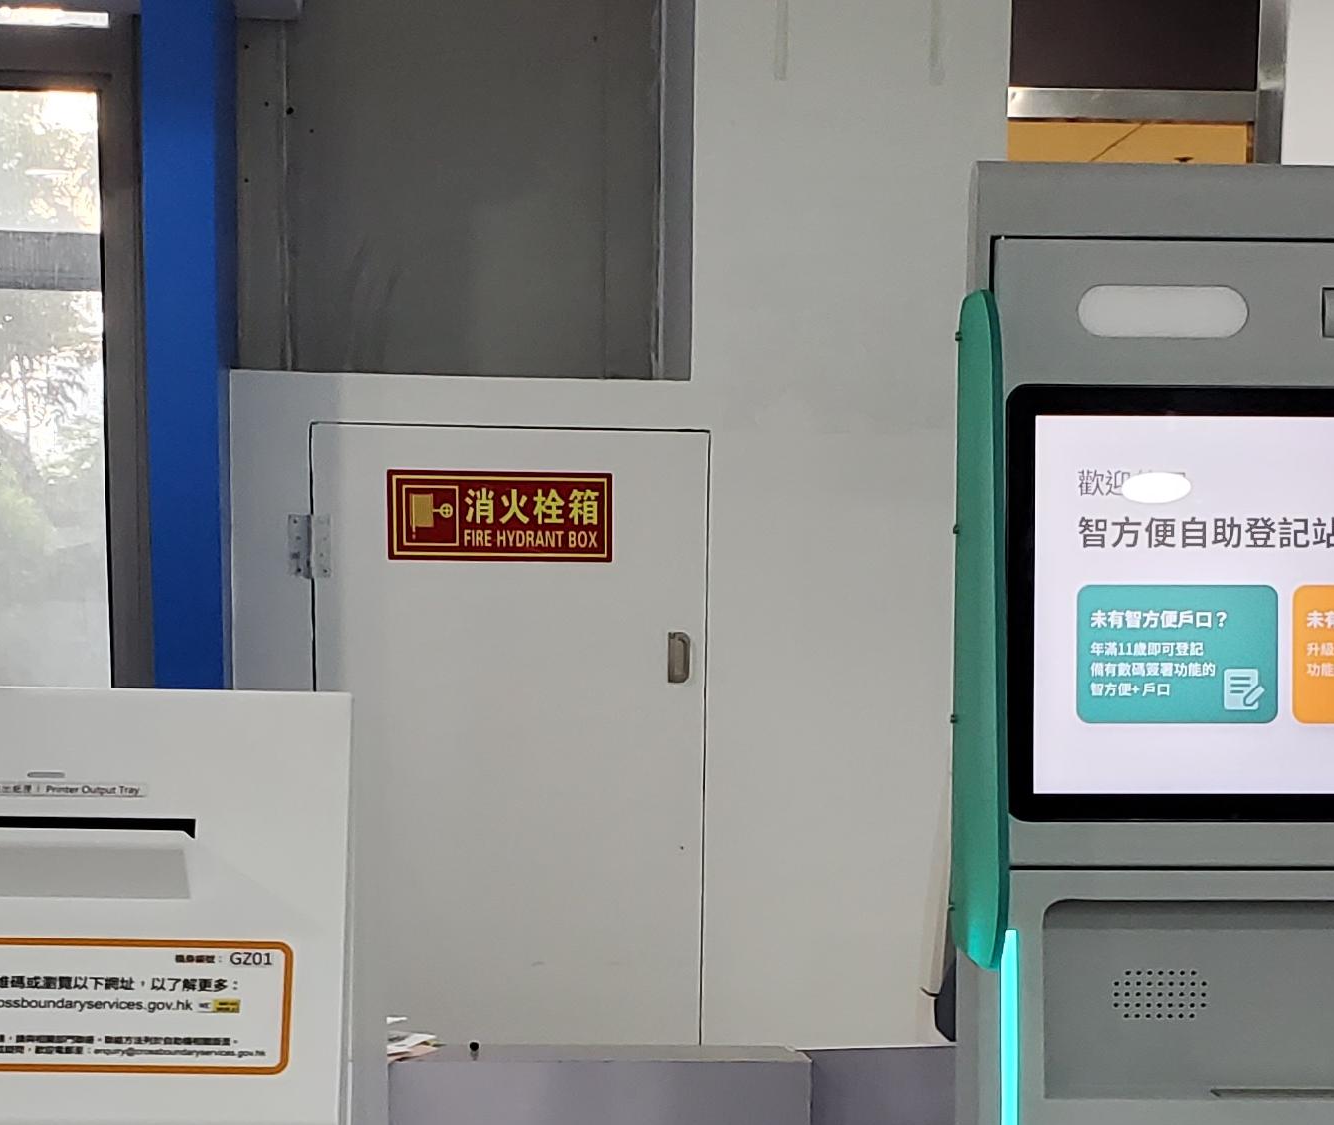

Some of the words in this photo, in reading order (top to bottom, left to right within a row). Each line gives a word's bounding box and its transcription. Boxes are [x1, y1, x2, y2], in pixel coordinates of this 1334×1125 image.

[464, 487, 600, 526] 消火栓箱
[464, 529, 492, 547] FIRE
[496, 530, 564, 548] HYDRANT
[568, 530, 598, 548] BOX
[1090, 609, 1229, 630] 未有智方便戶口？
[1090, 641, 1204, 657] 年滿11歲即可登記
[1142, 682, 1171, 697] 戶口
[45, 784, 79, 795] Printer
[81, 784, 117, 797] Output
[119, 784, 140, 796] Tray
[229, 951, 273, 966] GZ01
